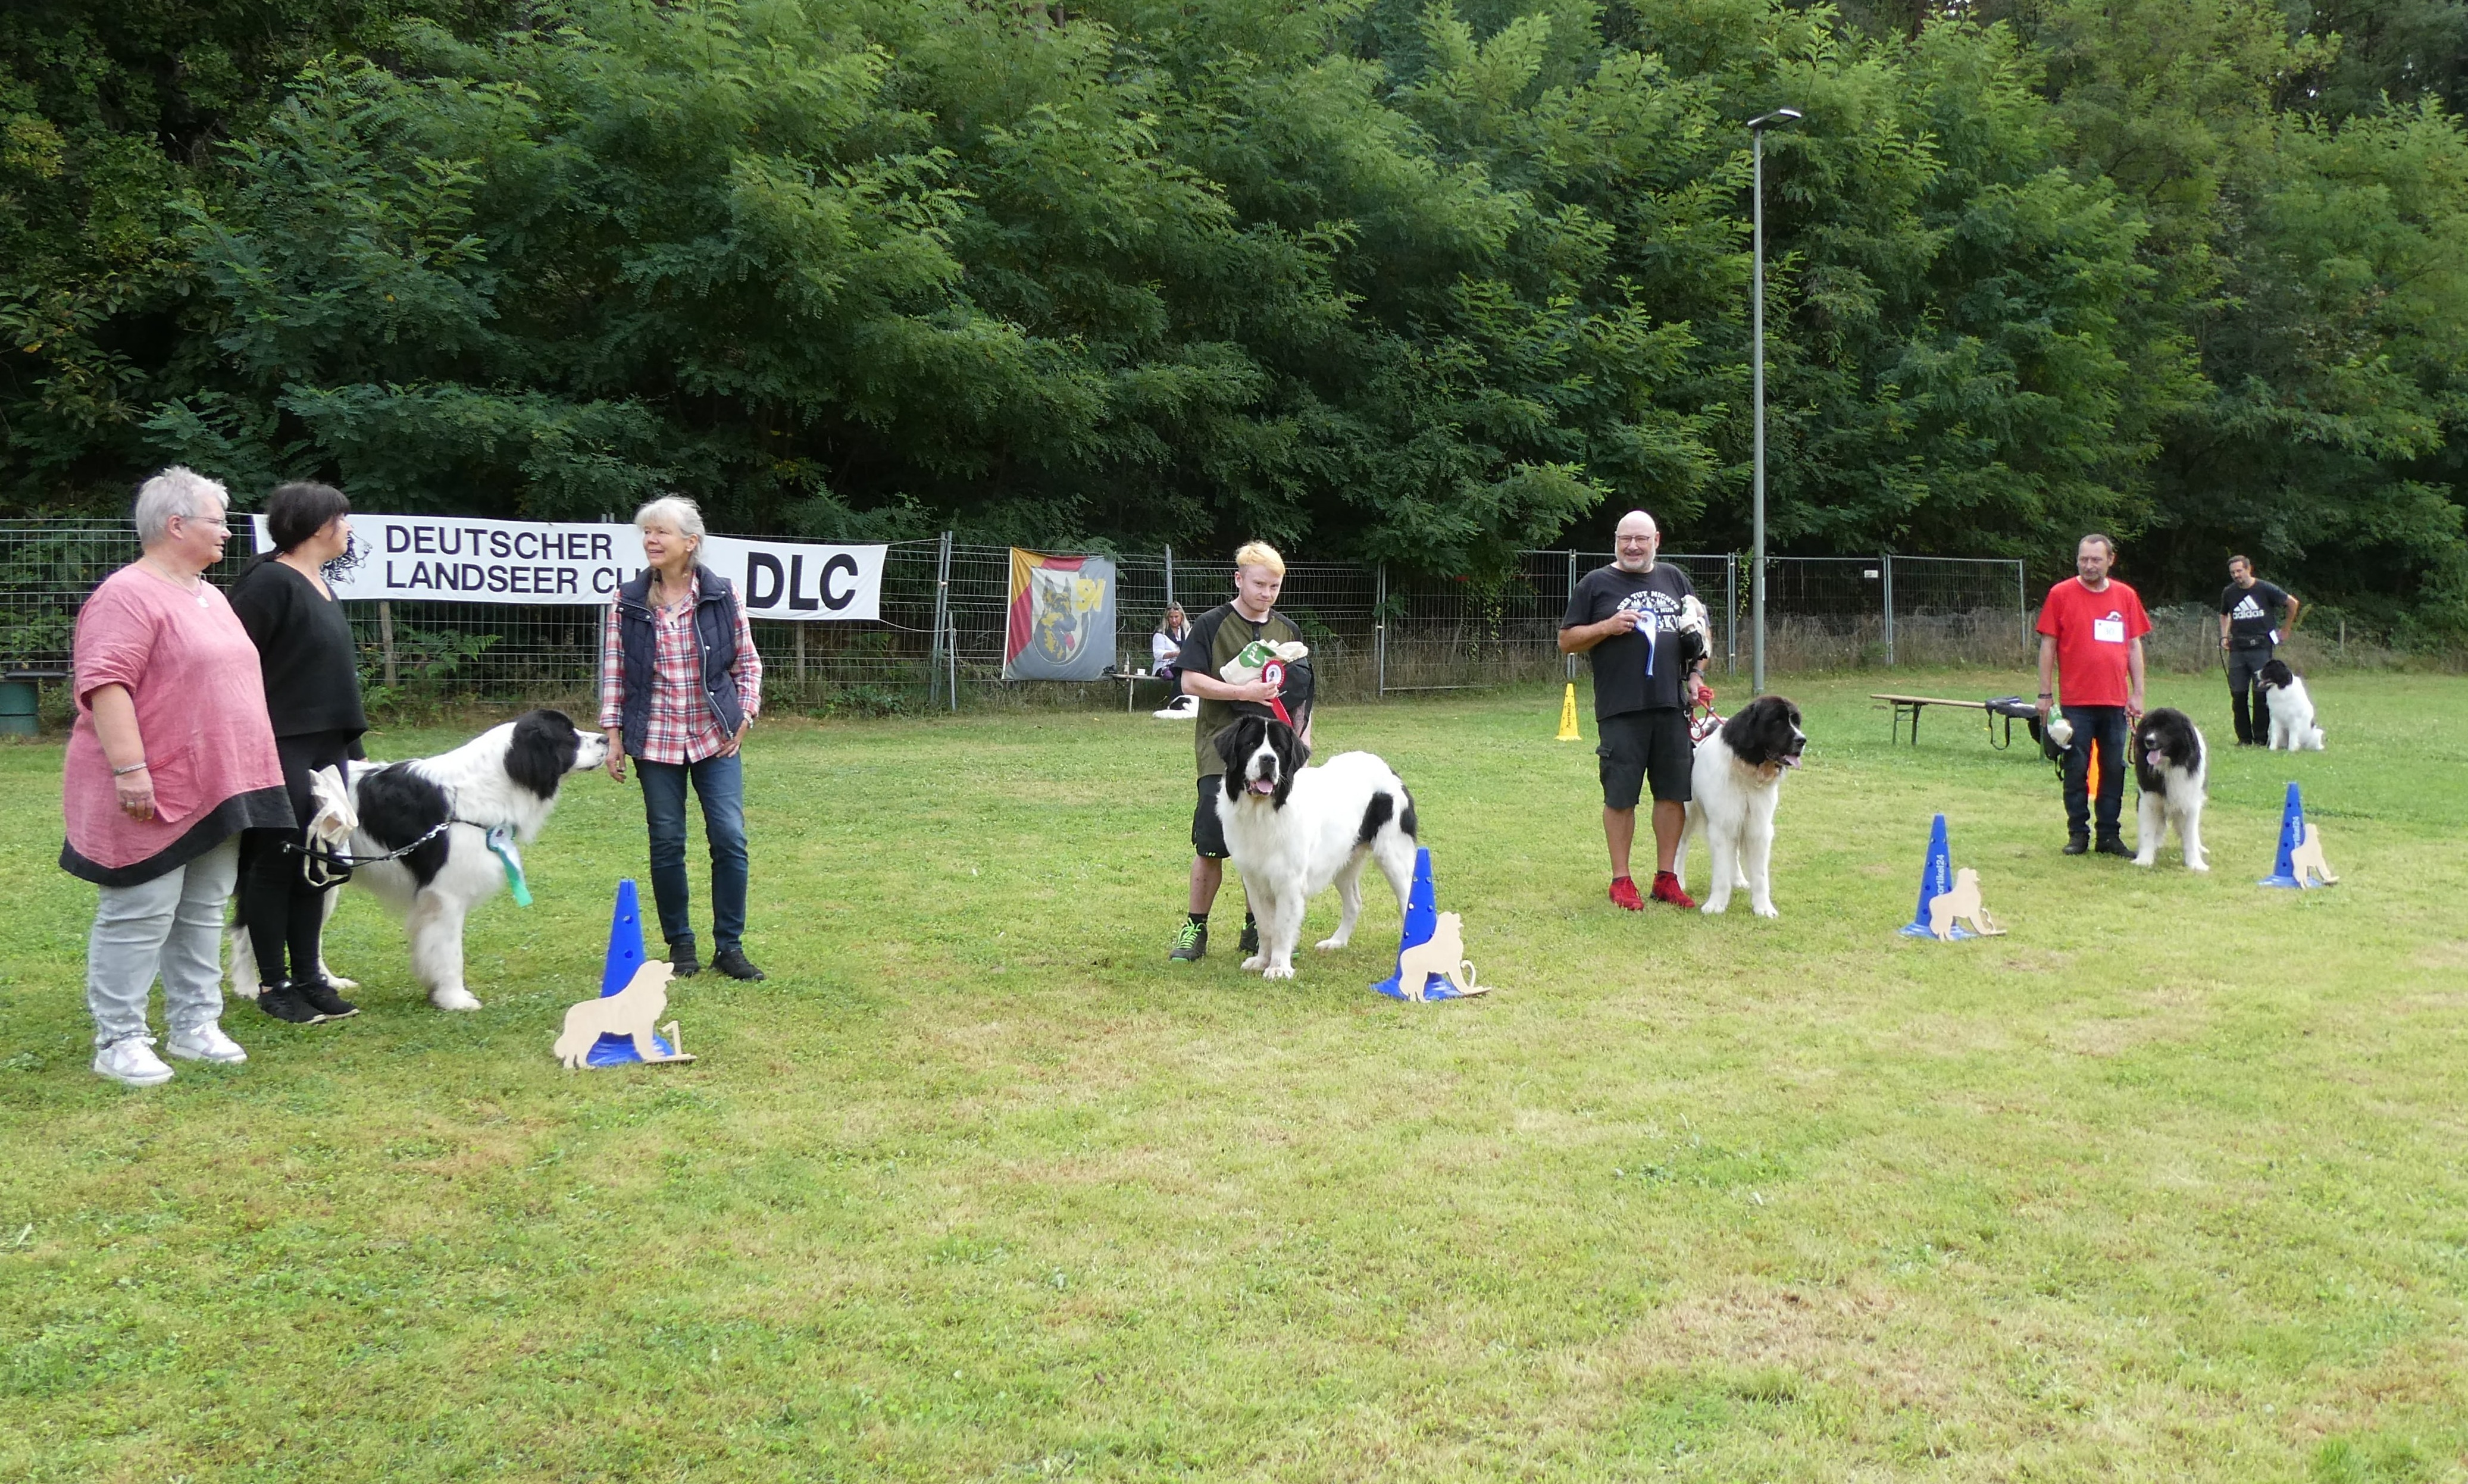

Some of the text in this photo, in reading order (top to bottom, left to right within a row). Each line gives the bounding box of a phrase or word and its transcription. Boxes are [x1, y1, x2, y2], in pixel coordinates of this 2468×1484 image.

[386, 525, 612, 561] DEUTSCHER
[386, 560, 578, 594] LANDSEER
[746, 552, 859, 611] DLC
[1630, 591, 1648, 600] TUT
[1651, 591, 1679, 610] NICHTS
[2232, 609, 2264, 619] adidas
